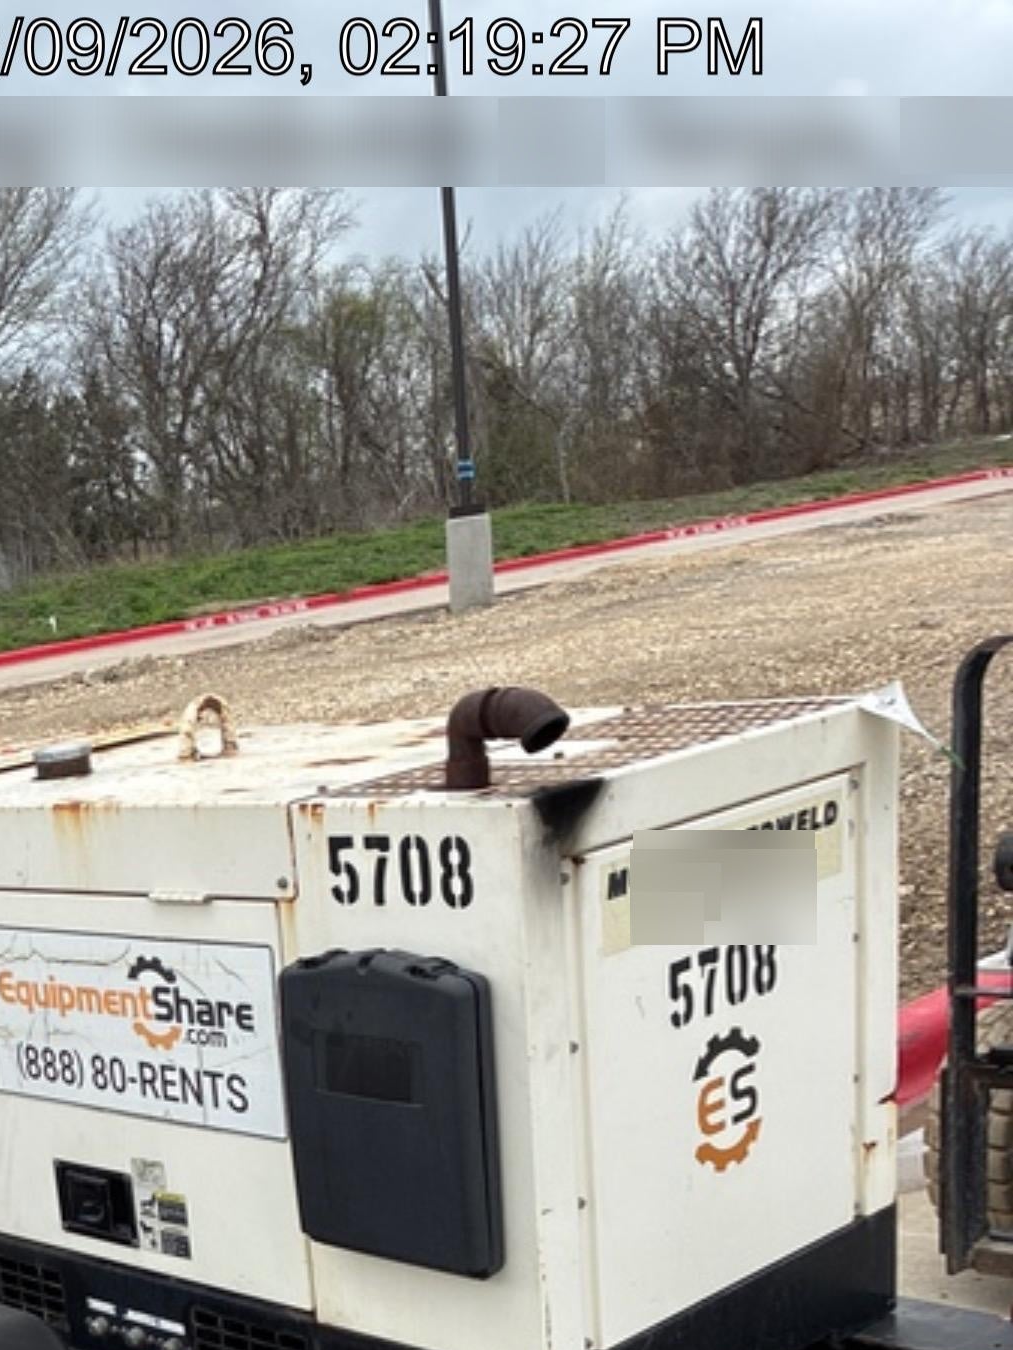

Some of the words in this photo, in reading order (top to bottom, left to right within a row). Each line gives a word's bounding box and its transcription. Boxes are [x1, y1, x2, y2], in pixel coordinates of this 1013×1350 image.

[328, 834, 474, 909] 5708
[669, 945, 776, 1029] 5708
[16, 1041, 85, 1089] (888)
[91, 1054, 250, 1114] 80-RENTS
[698, 1062, 757, 1135] ES
